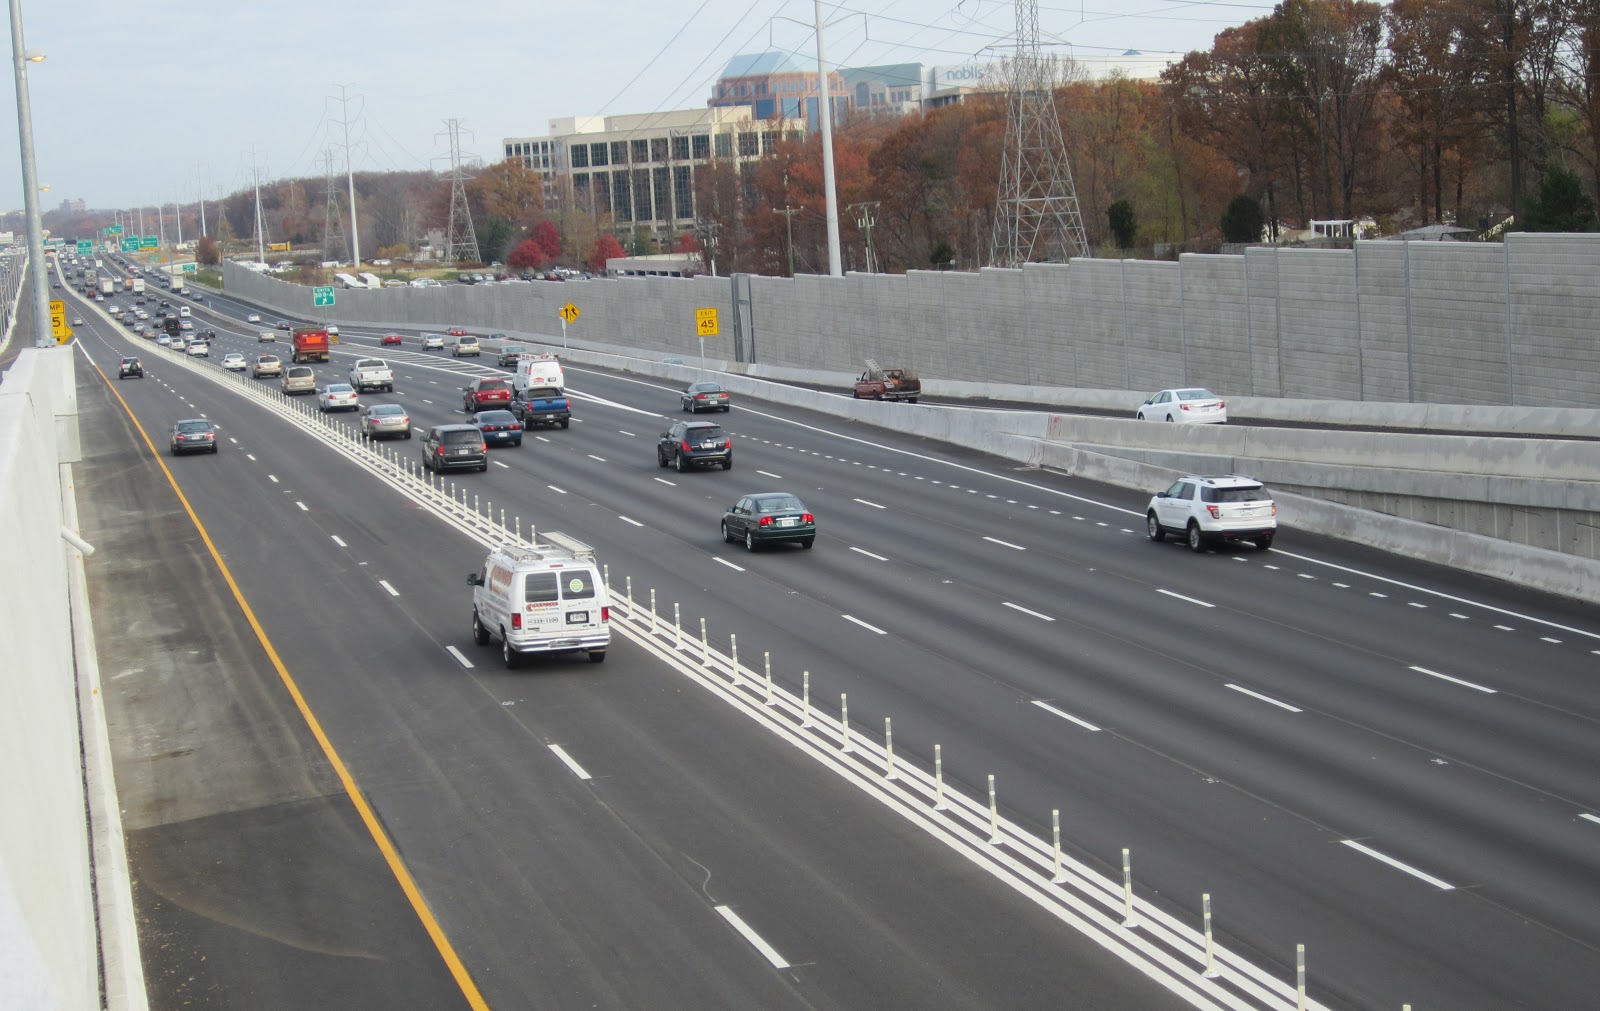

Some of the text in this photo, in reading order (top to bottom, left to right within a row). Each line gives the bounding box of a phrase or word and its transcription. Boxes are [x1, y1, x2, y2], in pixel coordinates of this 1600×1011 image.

[947, 66, 984, 80] noblis
[52, 316, 61, 327] 5
[701, 319, 714, 328] 45
